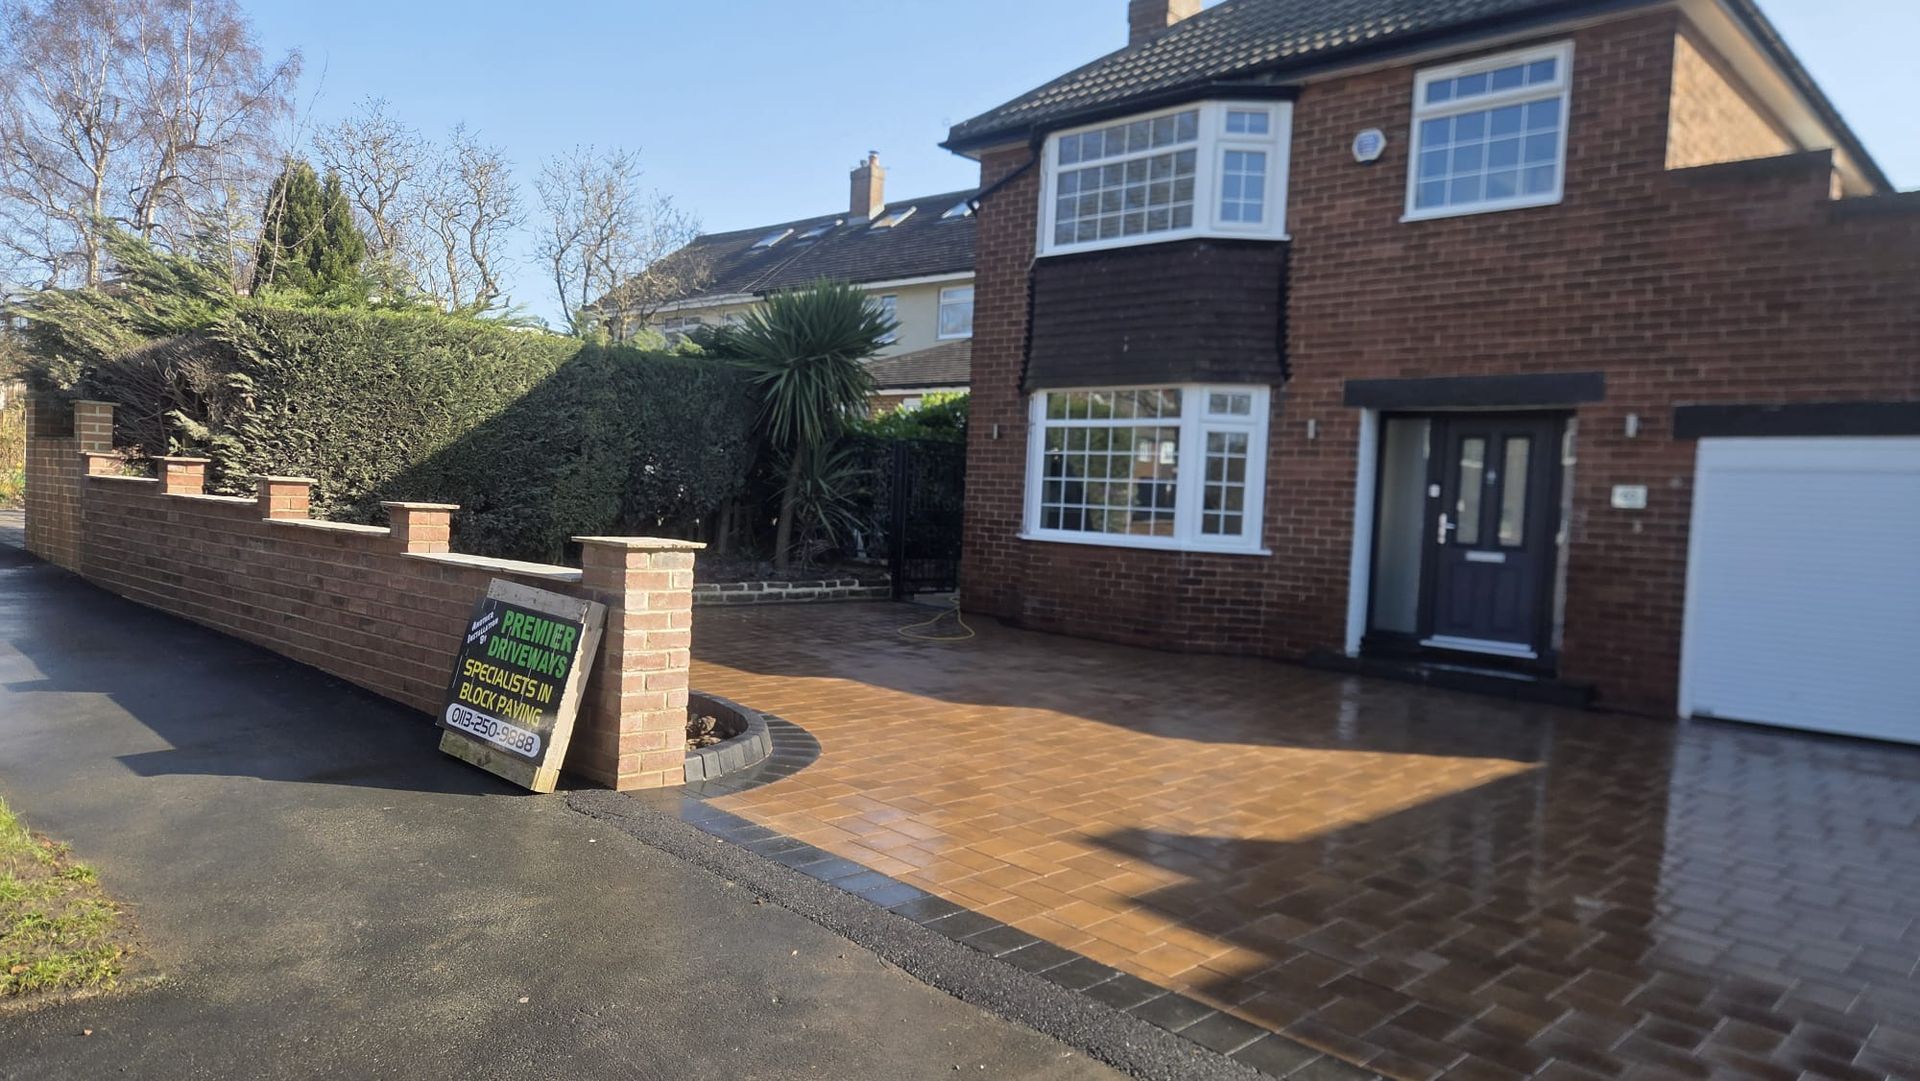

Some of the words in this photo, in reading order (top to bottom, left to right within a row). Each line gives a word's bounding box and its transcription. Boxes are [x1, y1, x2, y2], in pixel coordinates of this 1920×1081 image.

[501, 610, 576, 653] PREMIER
[488, 635, 568, 679] DRIVEWAYS
[464, 659, 537, 698] SPECIALISTS
[537, 683, 553, 703] IN
[459, 682, 495, 712] BLOCK
[496, 695, 543, 727] PAVING
[451, 707, 535, 752] 0113-250-9888
